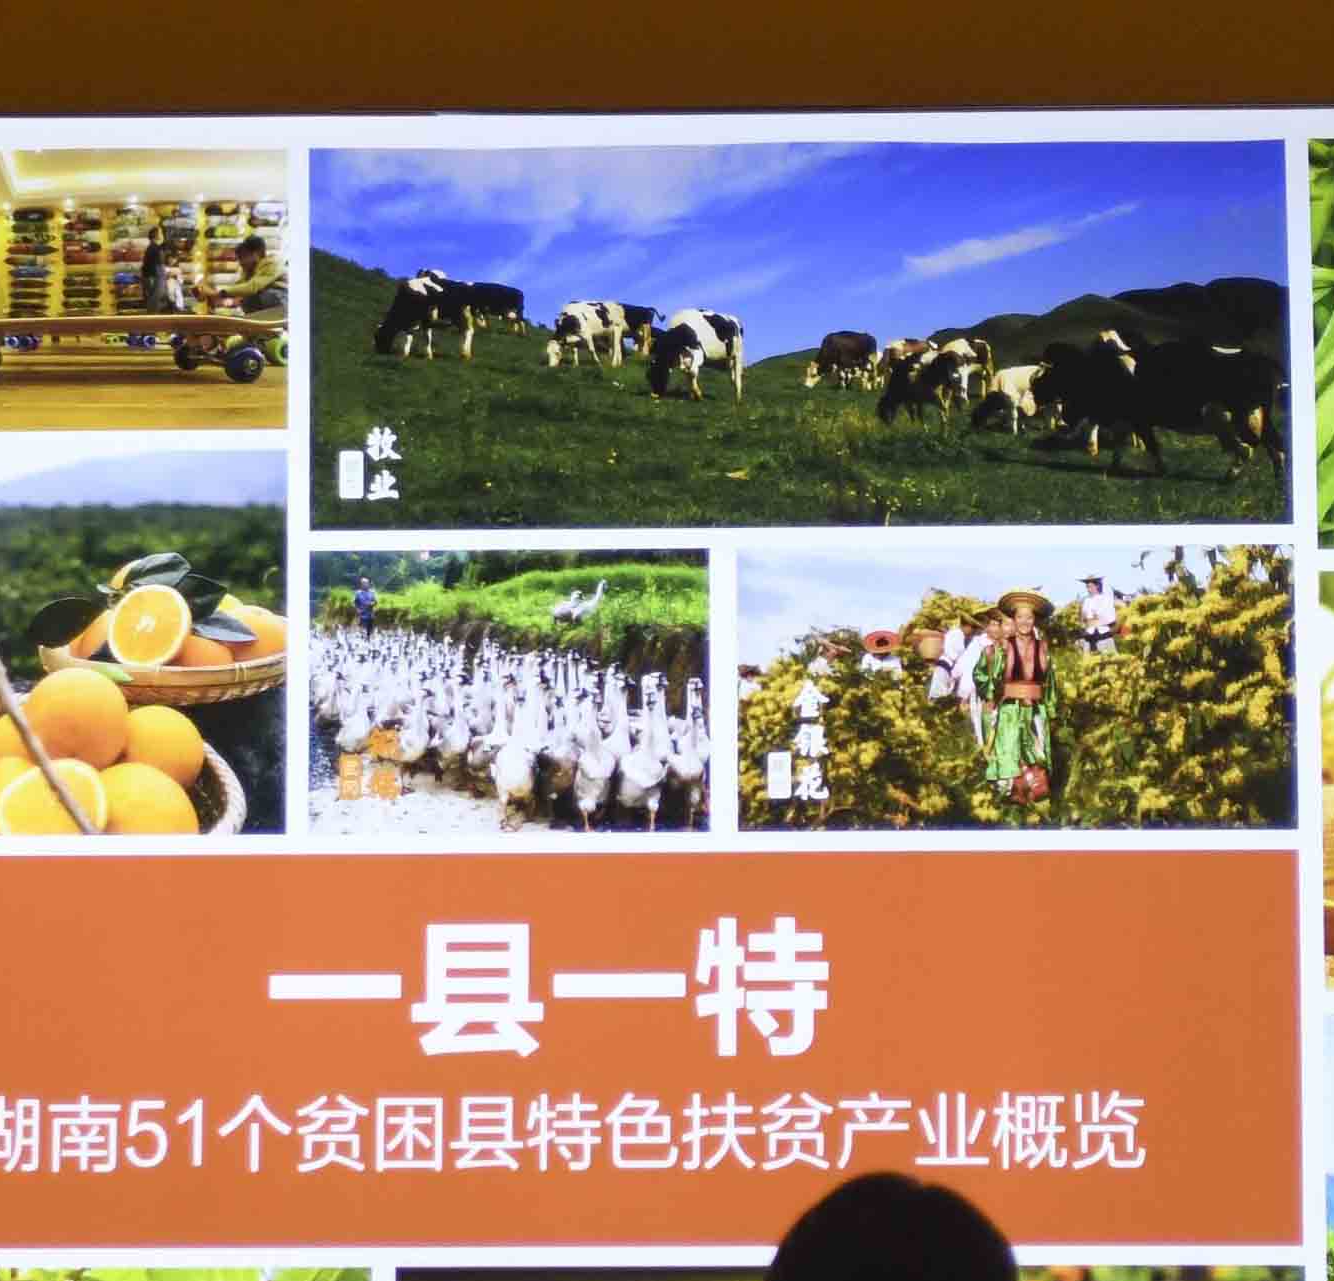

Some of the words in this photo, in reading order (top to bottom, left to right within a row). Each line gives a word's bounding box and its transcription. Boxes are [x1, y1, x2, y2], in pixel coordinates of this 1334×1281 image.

[366, 426, 402, 501] 牧业
[269, 915, 830, 1058] 一县一特
